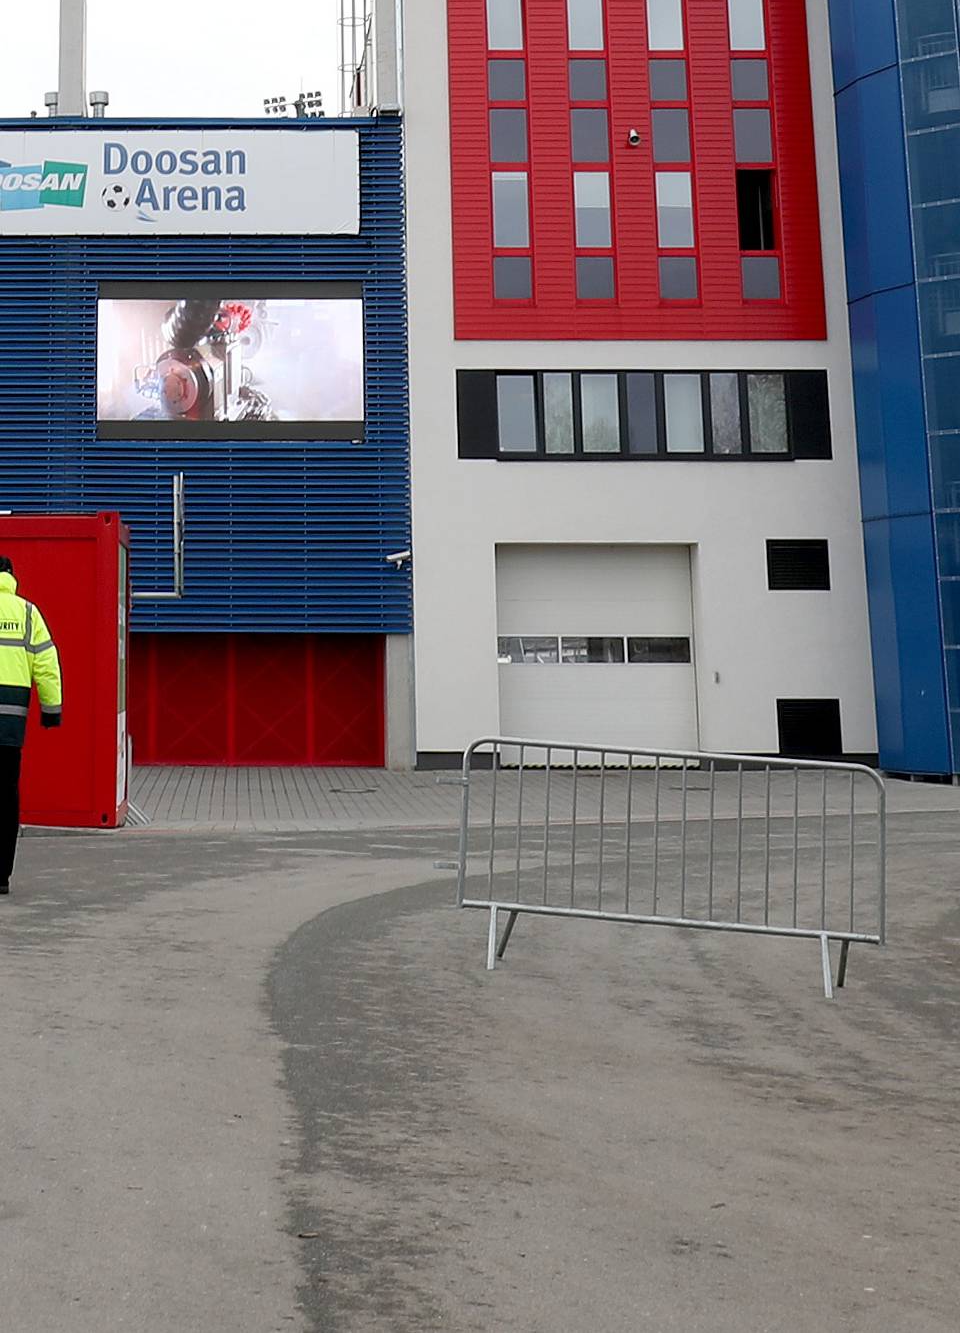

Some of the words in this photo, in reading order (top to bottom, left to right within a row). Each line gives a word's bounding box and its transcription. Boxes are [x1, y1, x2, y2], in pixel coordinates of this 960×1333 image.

[103, 142, 246, 176] Doosan
[0, 172, 84, 191] OSAN
[134, 177, 247, 212] Arena
